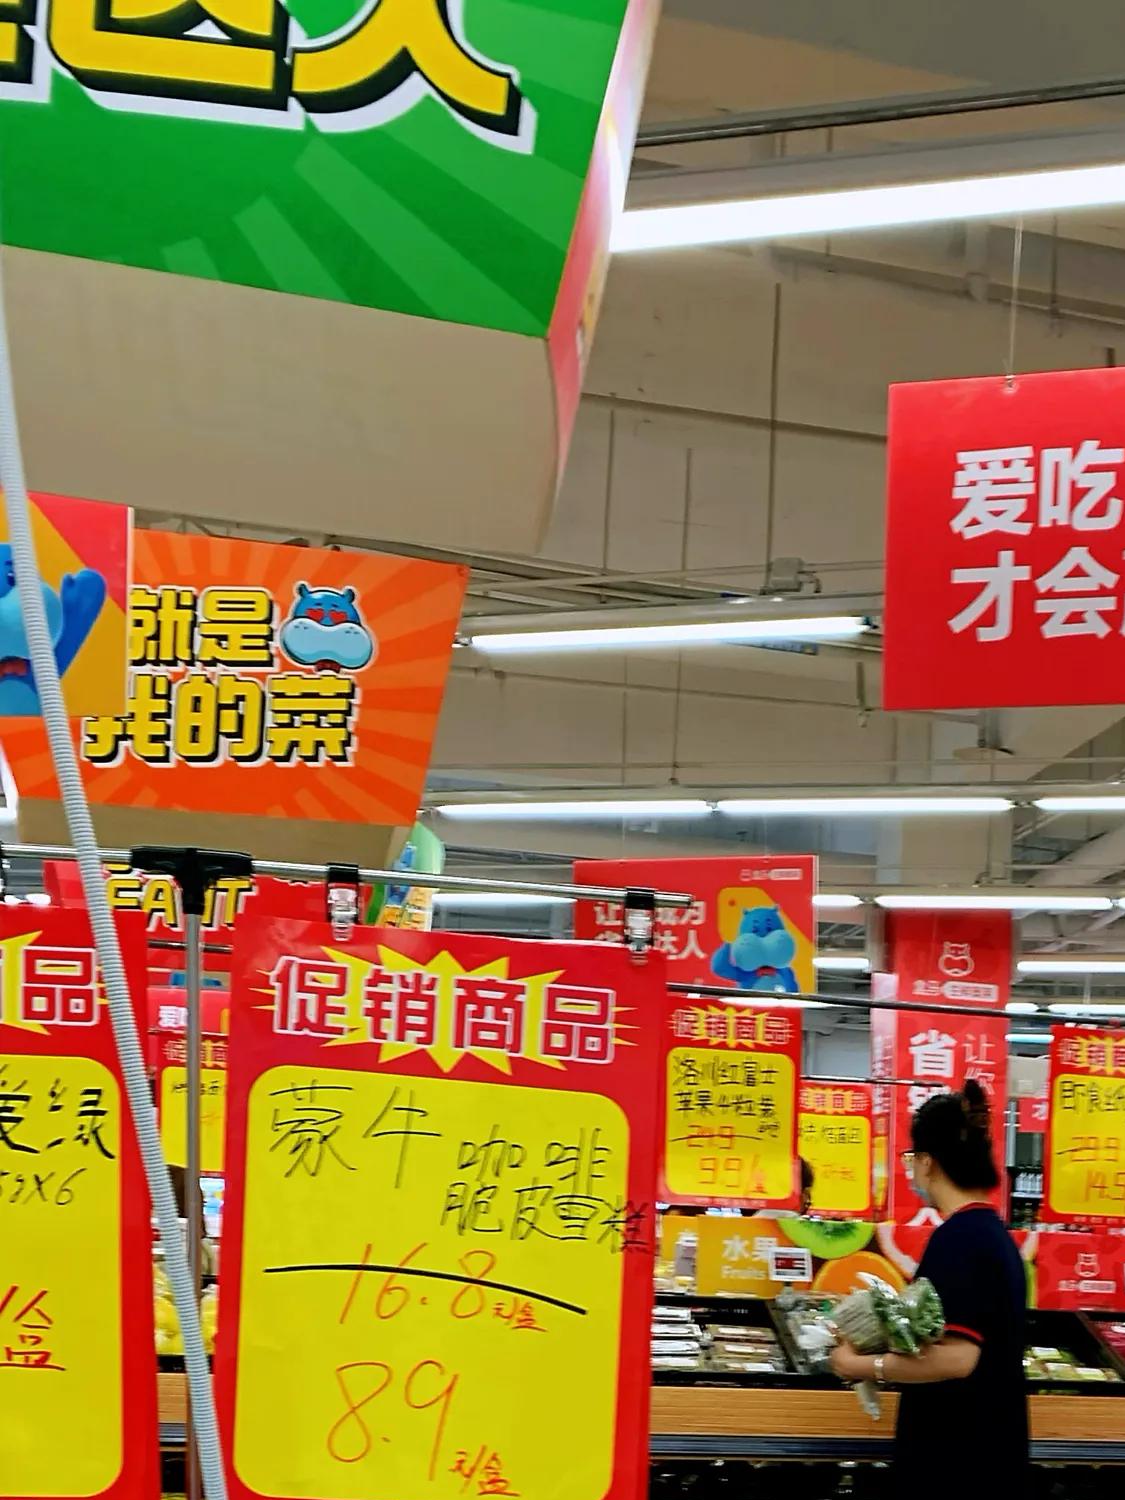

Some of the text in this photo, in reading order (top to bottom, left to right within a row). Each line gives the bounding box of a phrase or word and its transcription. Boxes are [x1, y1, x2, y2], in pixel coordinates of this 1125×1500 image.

[128, 585, 276, 668] 就是
[270, 955, 616, 1063] 促销商品
[269, 1080, 613, 1196] 蒙牛 咖啡
